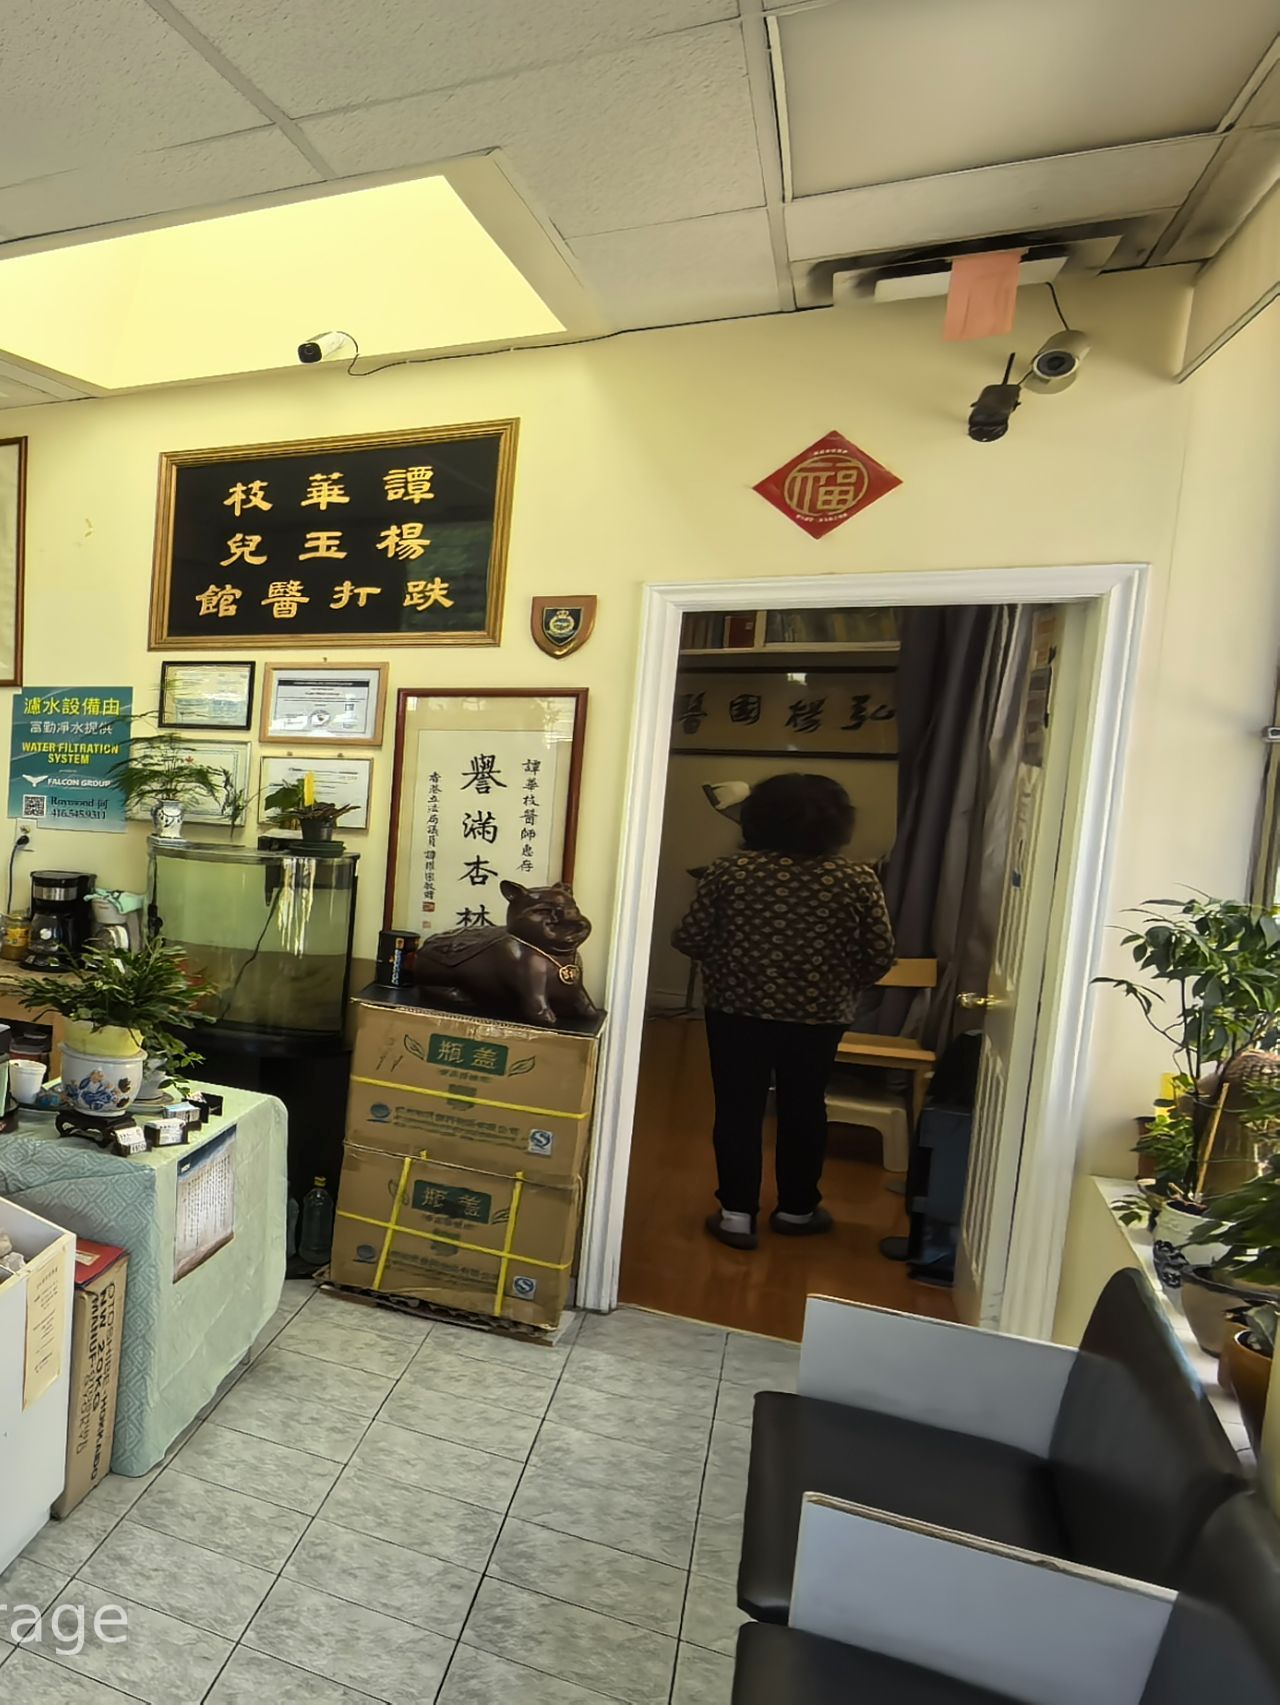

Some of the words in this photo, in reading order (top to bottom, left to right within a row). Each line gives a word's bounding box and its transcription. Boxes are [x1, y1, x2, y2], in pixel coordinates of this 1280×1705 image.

[223, 466, 435, 516] 譚華枝
[219, 522, 431, 566] 楊玉兒
[196, 577, 455, 618] 跌打醫館
[24, 697, 120, 715] 濾水設備由
[22, 742, 55, 753] WATER
[59, 742, 119, 754] FILTRATION
[48, 754, 90, 764] SYSTEM
[48, 778, 79, 786] FALCON
